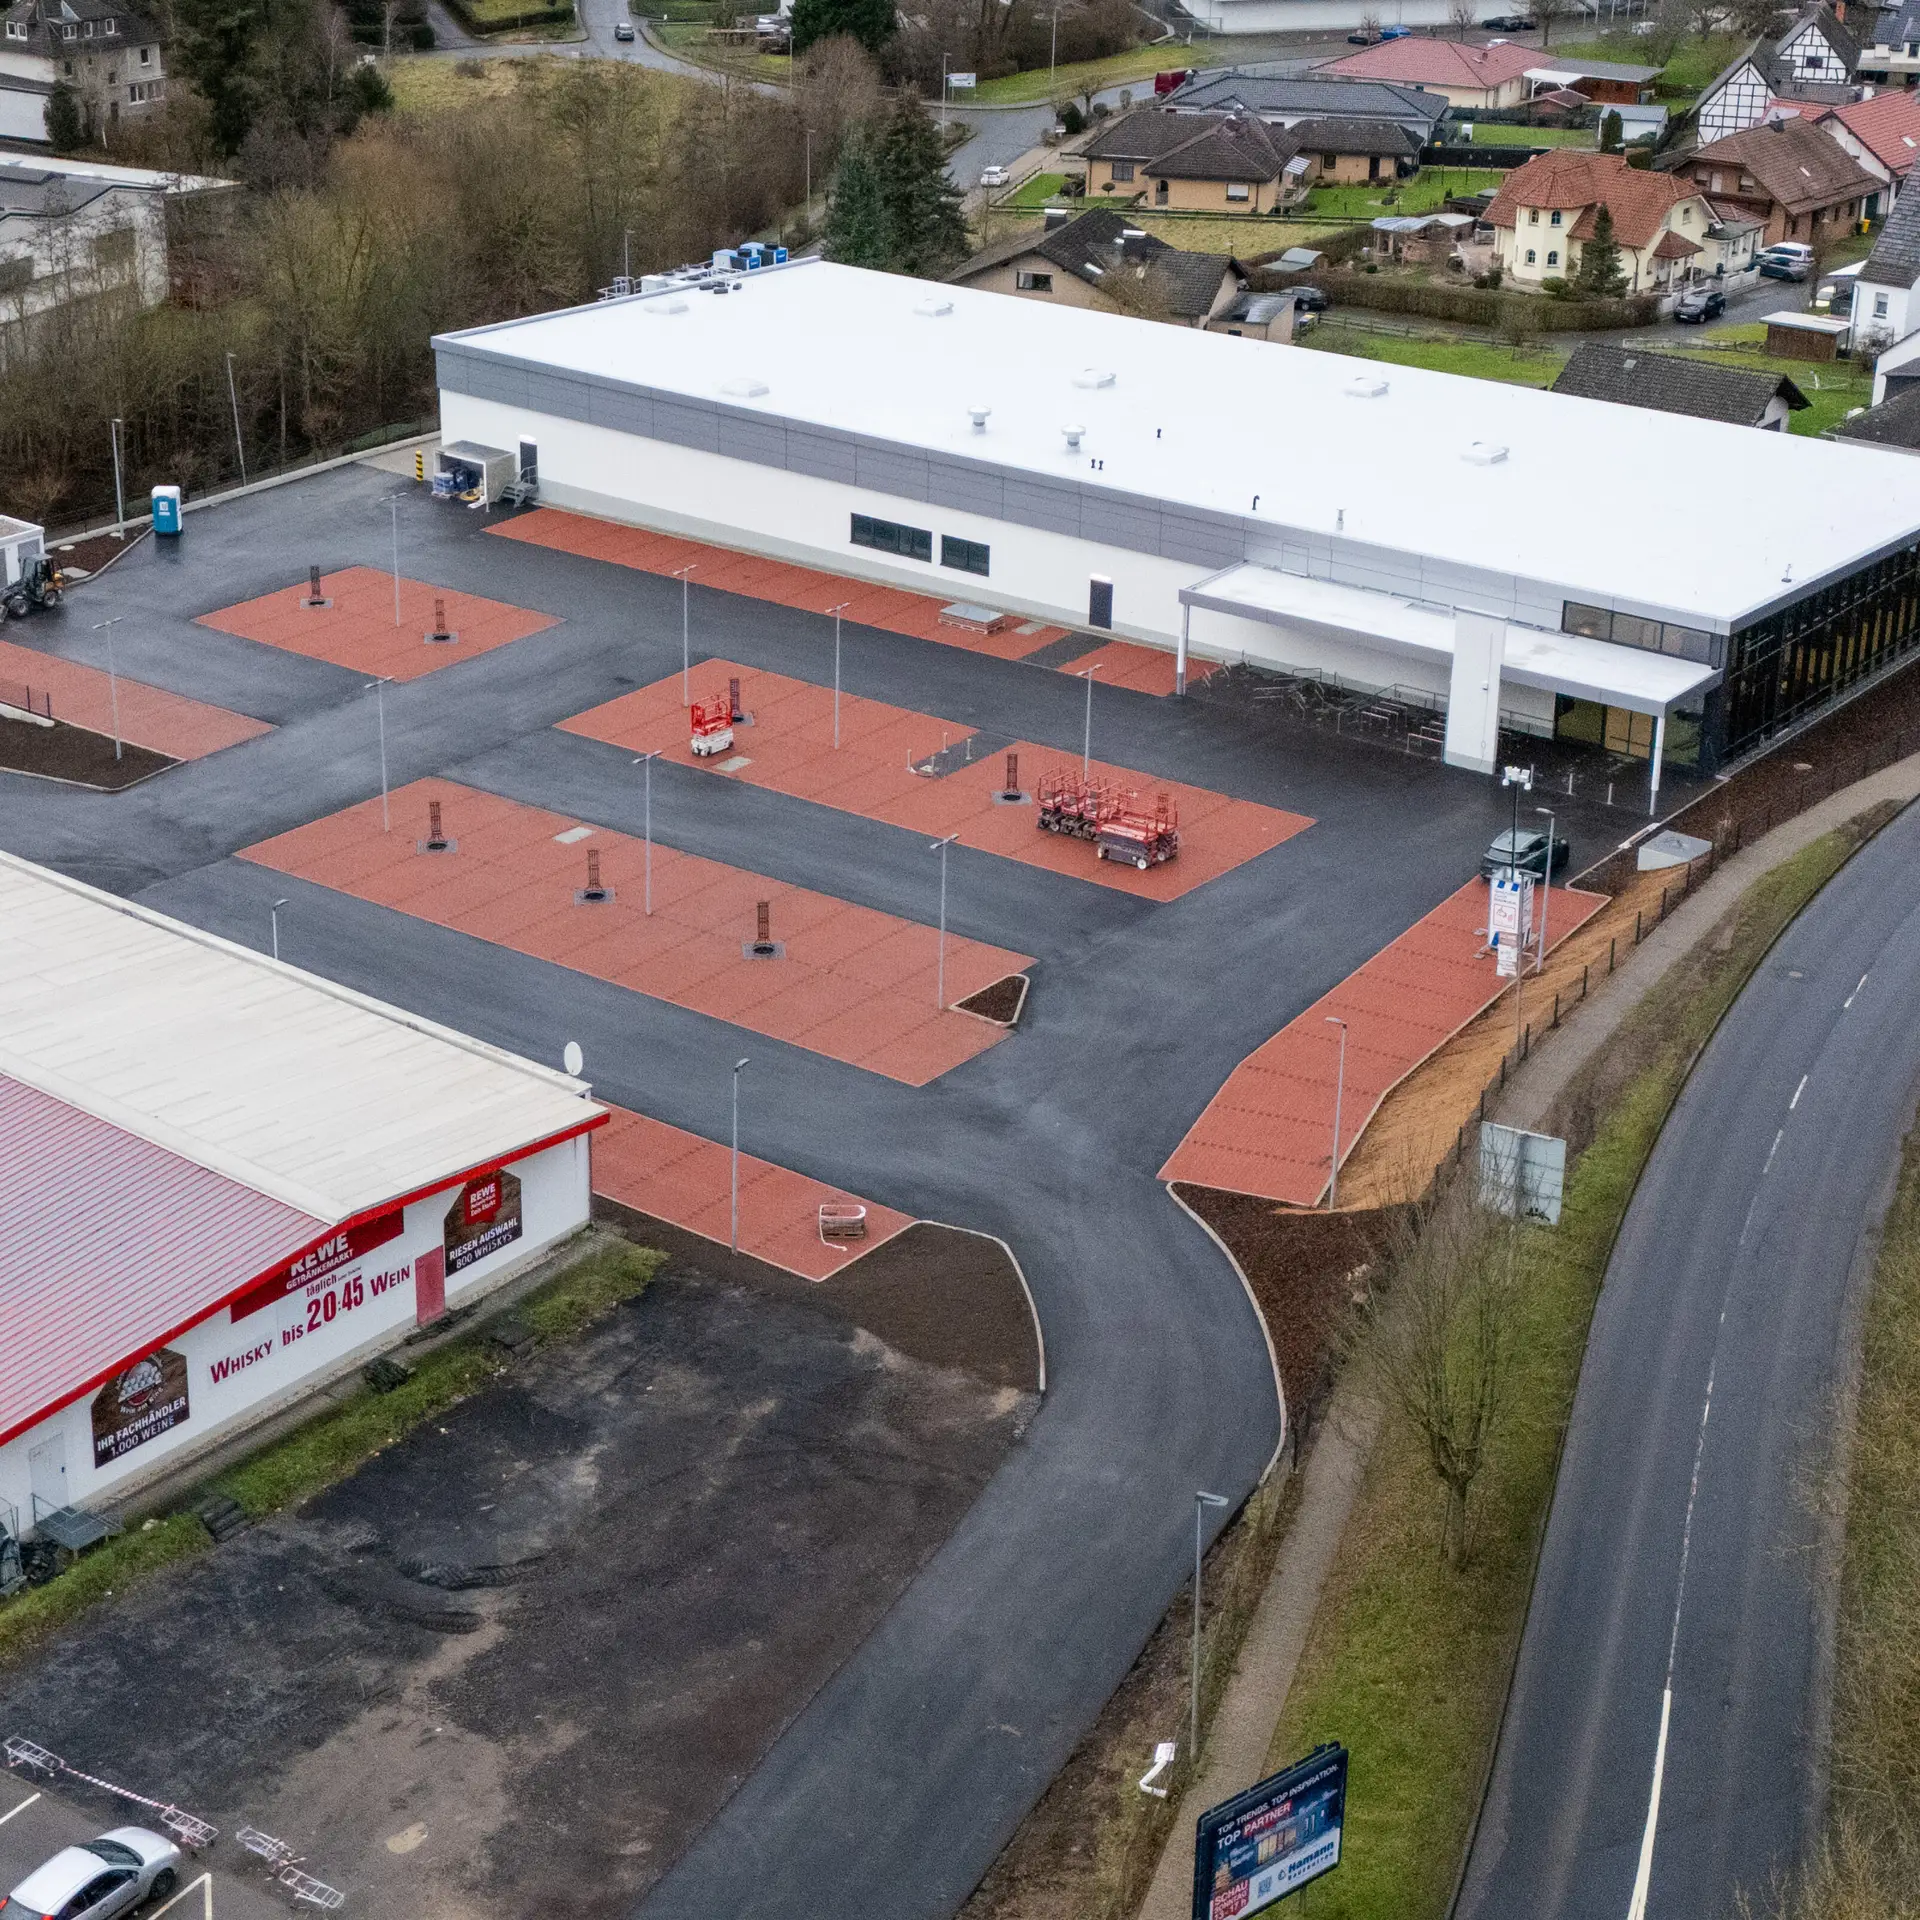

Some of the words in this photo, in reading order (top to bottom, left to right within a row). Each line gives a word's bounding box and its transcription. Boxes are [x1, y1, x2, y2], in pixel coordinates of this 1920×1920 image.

[470, 1183, 496, 1203] REWE
[449, 1239, 478, 1261] RIESEN
[480, 1217, 518, 1243] AUSWAHL
[456, 1253, 472, 1269] 800
[474, 1232, 512, 1259] WHISKYS
[286, 1248, 354, 1290] GETRÄNKEMARKT
[306, 1273, 338, 1298] täglich
[370, 1265, 411, 1297] WEIN
[282, 1324, 304, 1346] bis
[306, 1275, 364, 1334] 20:45
[210, 1339, 273, 1384] WHISKY
[97, 1434, 115, 1452] IHR
[116, 1396, 187, 1440] FACHHÄNDLER
[110, 1434, 139, 1457] 1.000
[141, 1415, 175, 1440] WEINE
[1218, 1821, 1235, 1836] TOP
[1236, 1802, 1270, 1825] TRENDS.
[1271, 1792, 1289, 1806] TOP
[1289, 1764, 1339, 1797] INSPIRATION.
[1217, 1830, 1241, 1850] TOP
[1243, 1802, 1292, 1836] PARTNER
[1288, 1842, 1334, 1873] Hamann
[1214, 1880, 1249, 1906] SCHAU
